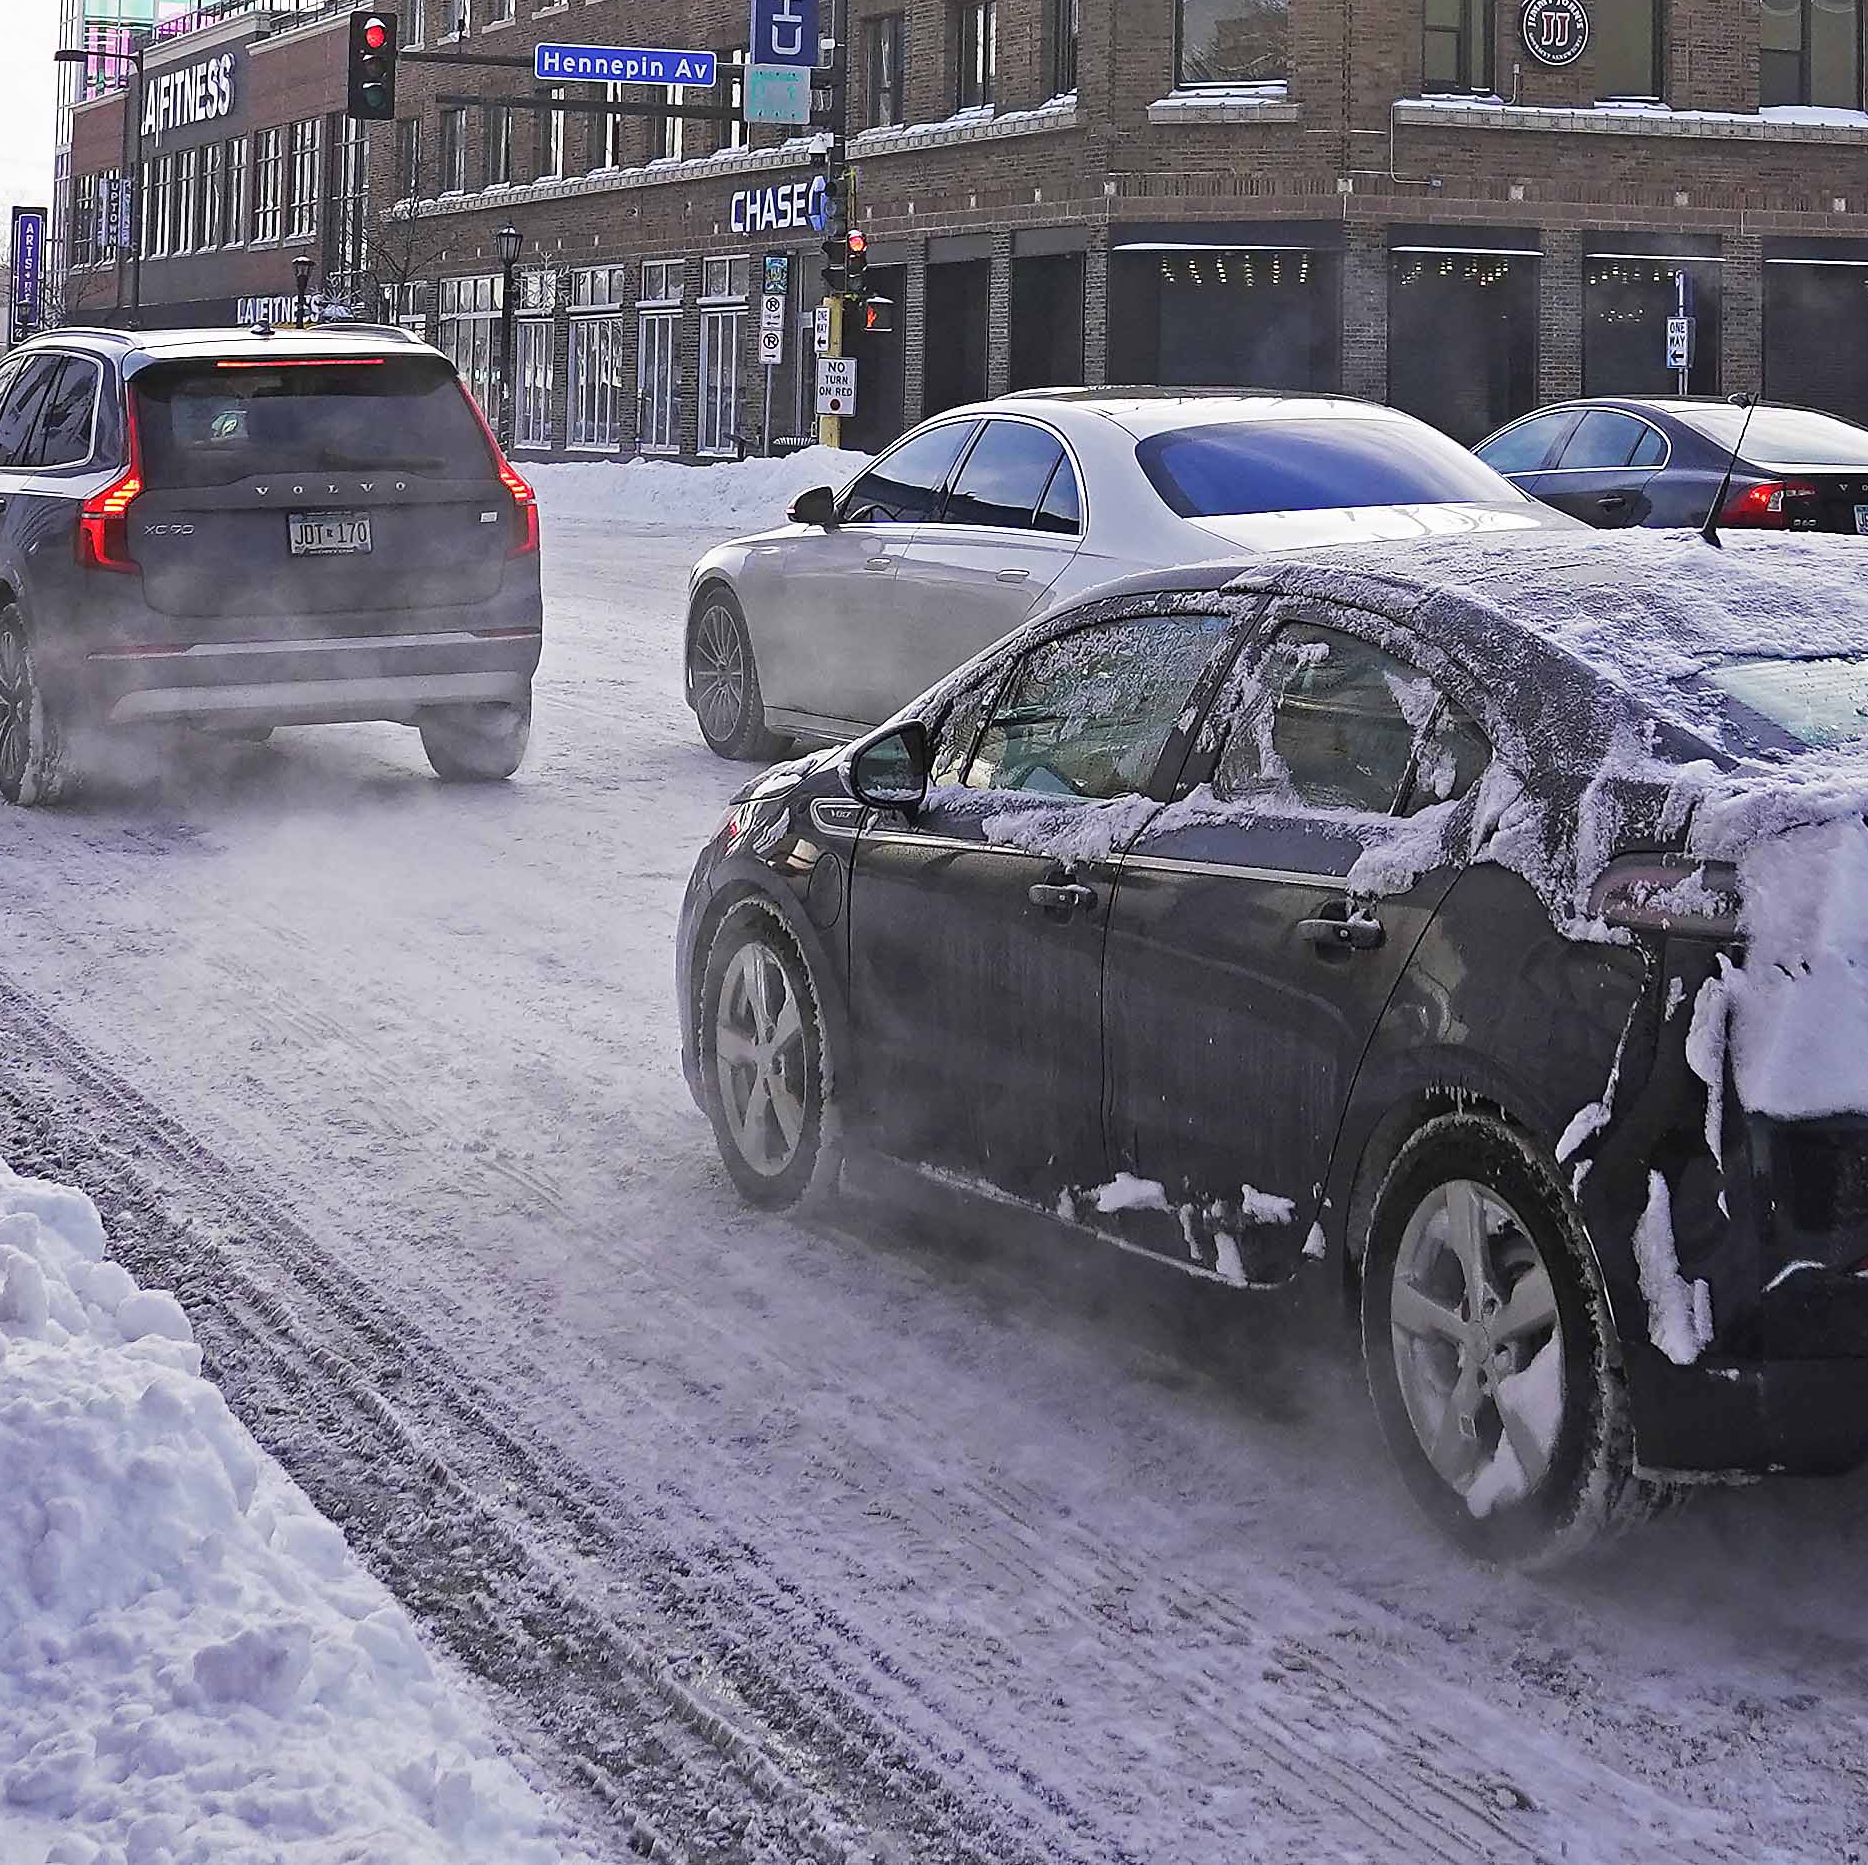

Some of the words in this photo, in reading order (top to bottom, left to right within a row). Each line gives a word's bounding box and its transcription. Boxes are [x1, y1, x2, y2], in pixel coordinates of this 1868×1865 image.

[1541, 11, 1571, 47] JJ
[542, 51, 665, 80] Hennepin
[674, 61, 708, 80] Av
[159, 53, 235, 131] FITNESS
[108, 181, 119, 245] UPTOWN
[730, 181, 808, 233] CHASE
[25, 222, 34, 270] ARTS
[1669, 321, 1686, 334] ONE
[1669, 336, 1686, 348] WAY
[827, 361, 846, 374] NO
[824, 374, 849, 385] TURN
[818, 386, 832, 397] ON
[835, 387, 853, 397] RED
[254, 481, 406, 496] VOLVO
[337, 522, 367, 544] 170
